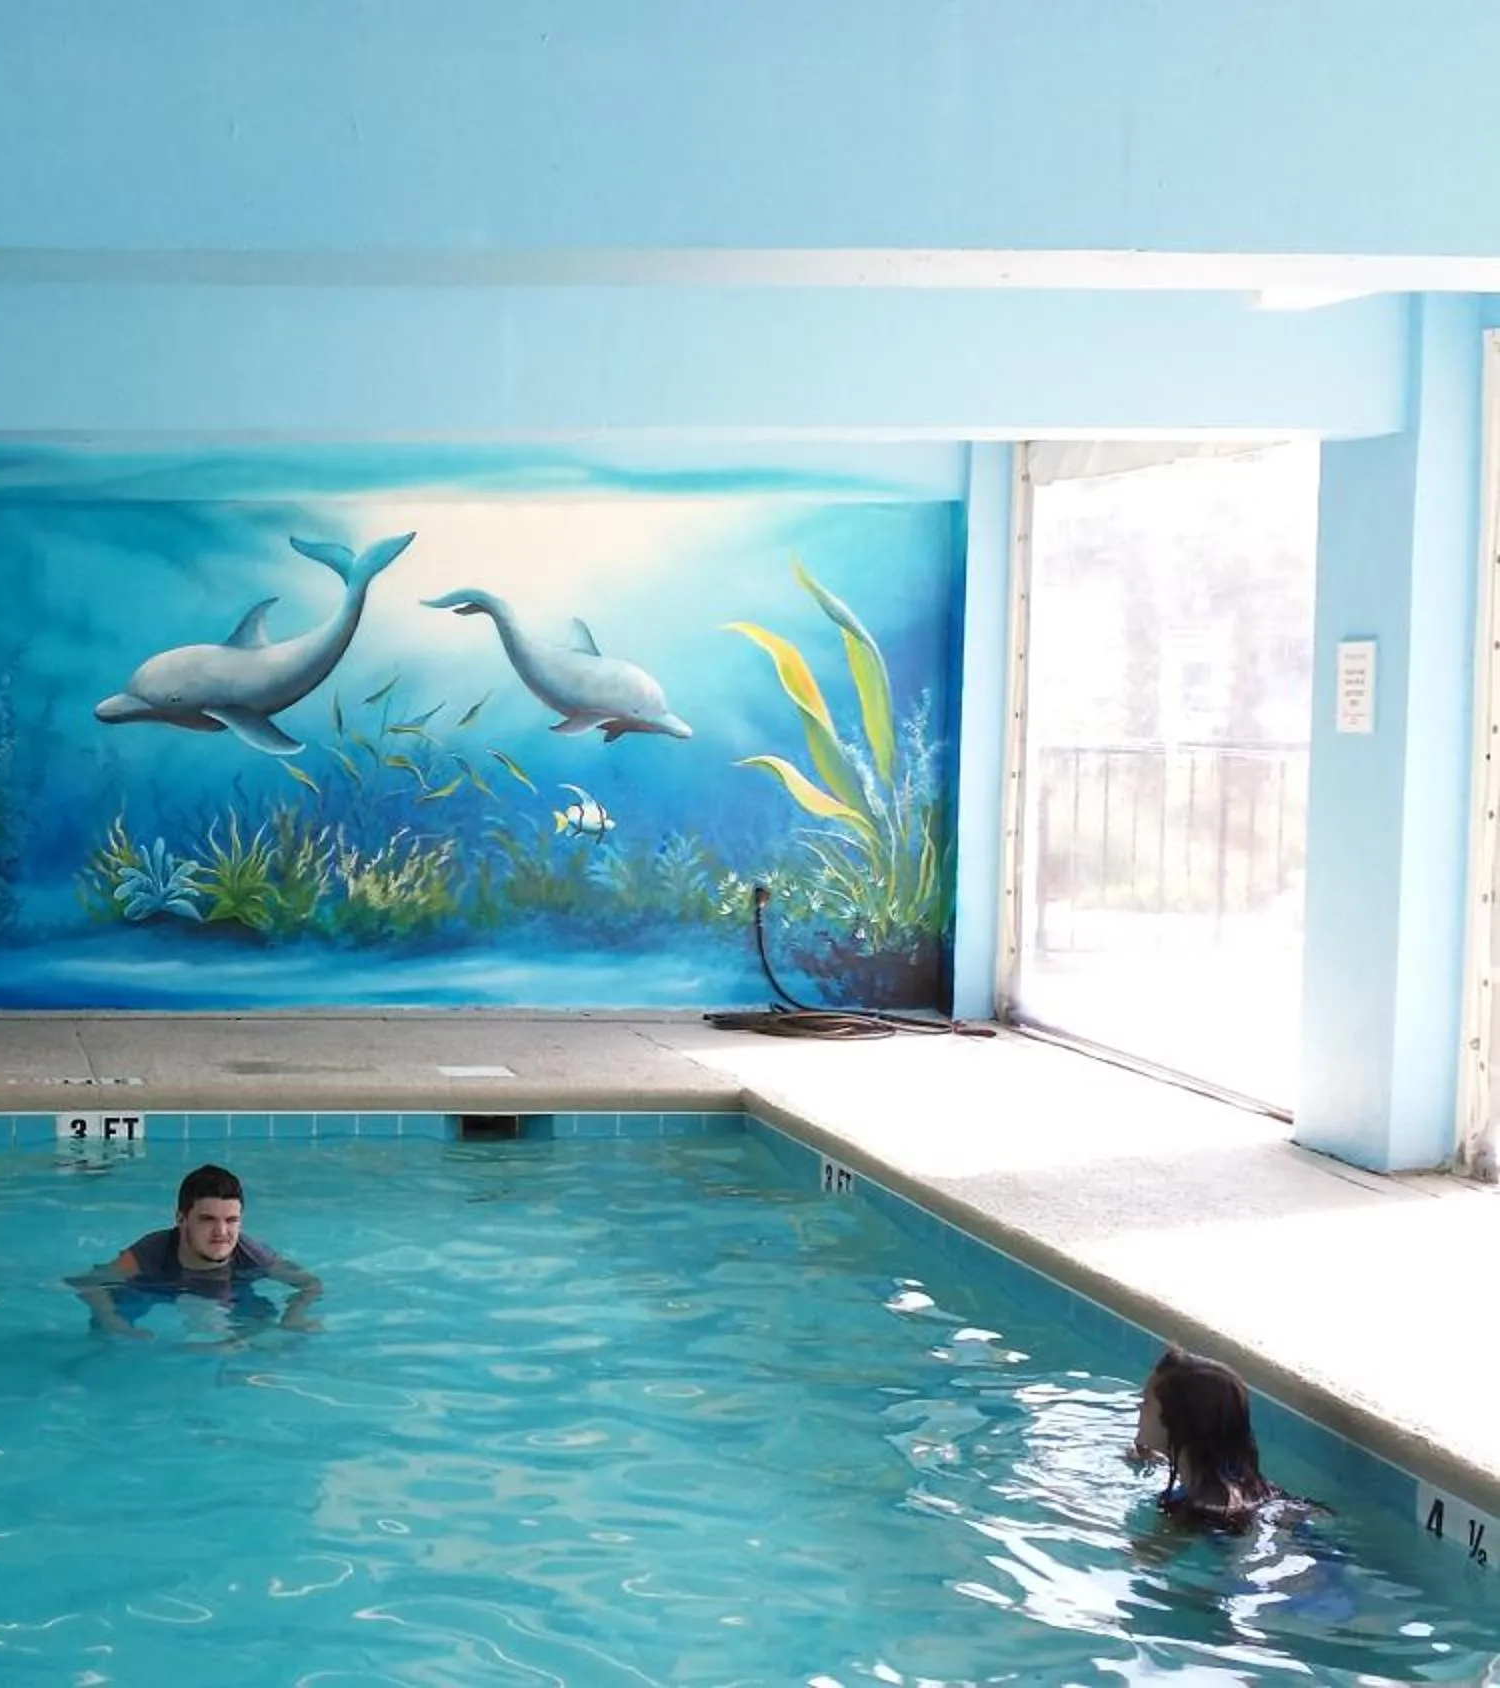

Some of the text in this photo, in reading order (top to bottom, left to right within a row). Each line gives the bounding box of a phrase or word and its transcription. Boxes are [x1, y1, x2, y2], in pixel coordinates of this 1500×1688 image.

[70, 1117, 140, 1141] 3 FT
[1426, 1498, 1445, 1539] 4
